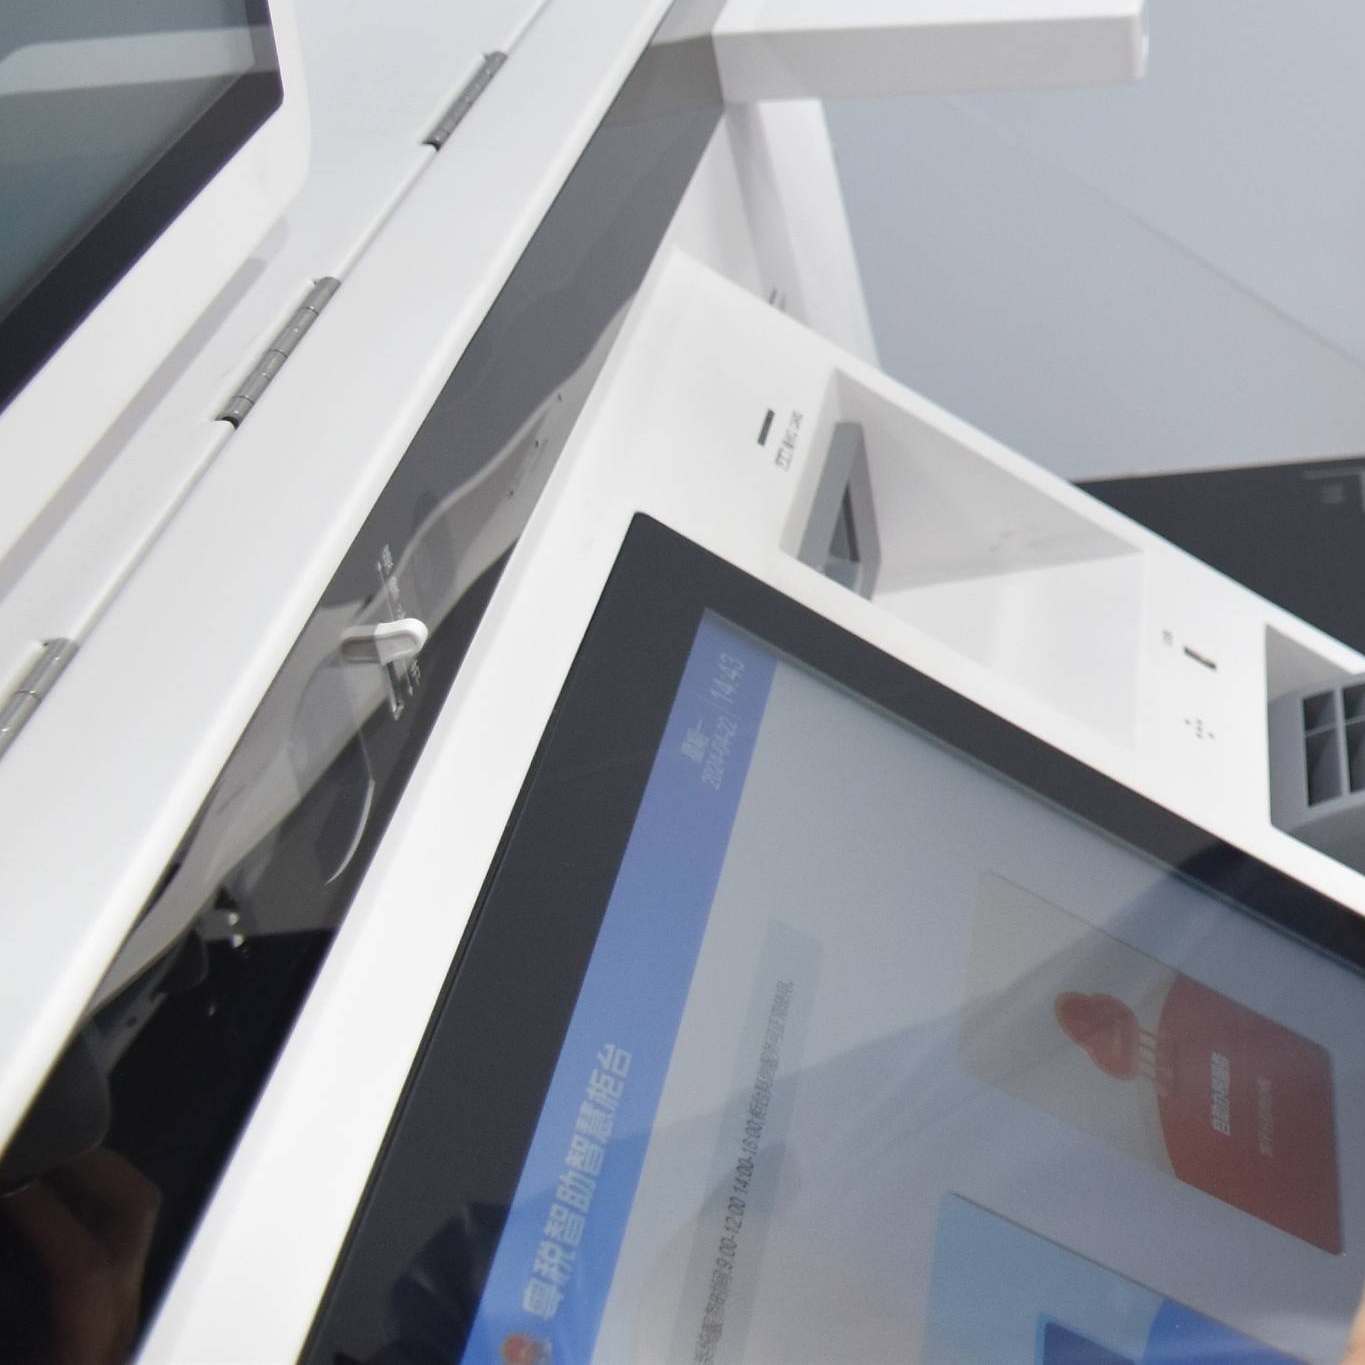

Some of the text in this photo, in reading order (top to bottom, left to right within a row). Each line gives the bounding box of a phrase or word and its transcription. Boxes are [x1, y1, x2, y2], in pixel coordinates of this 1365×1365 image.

[522, 1042, 633, 1321] 粤税智助智慧柜台
